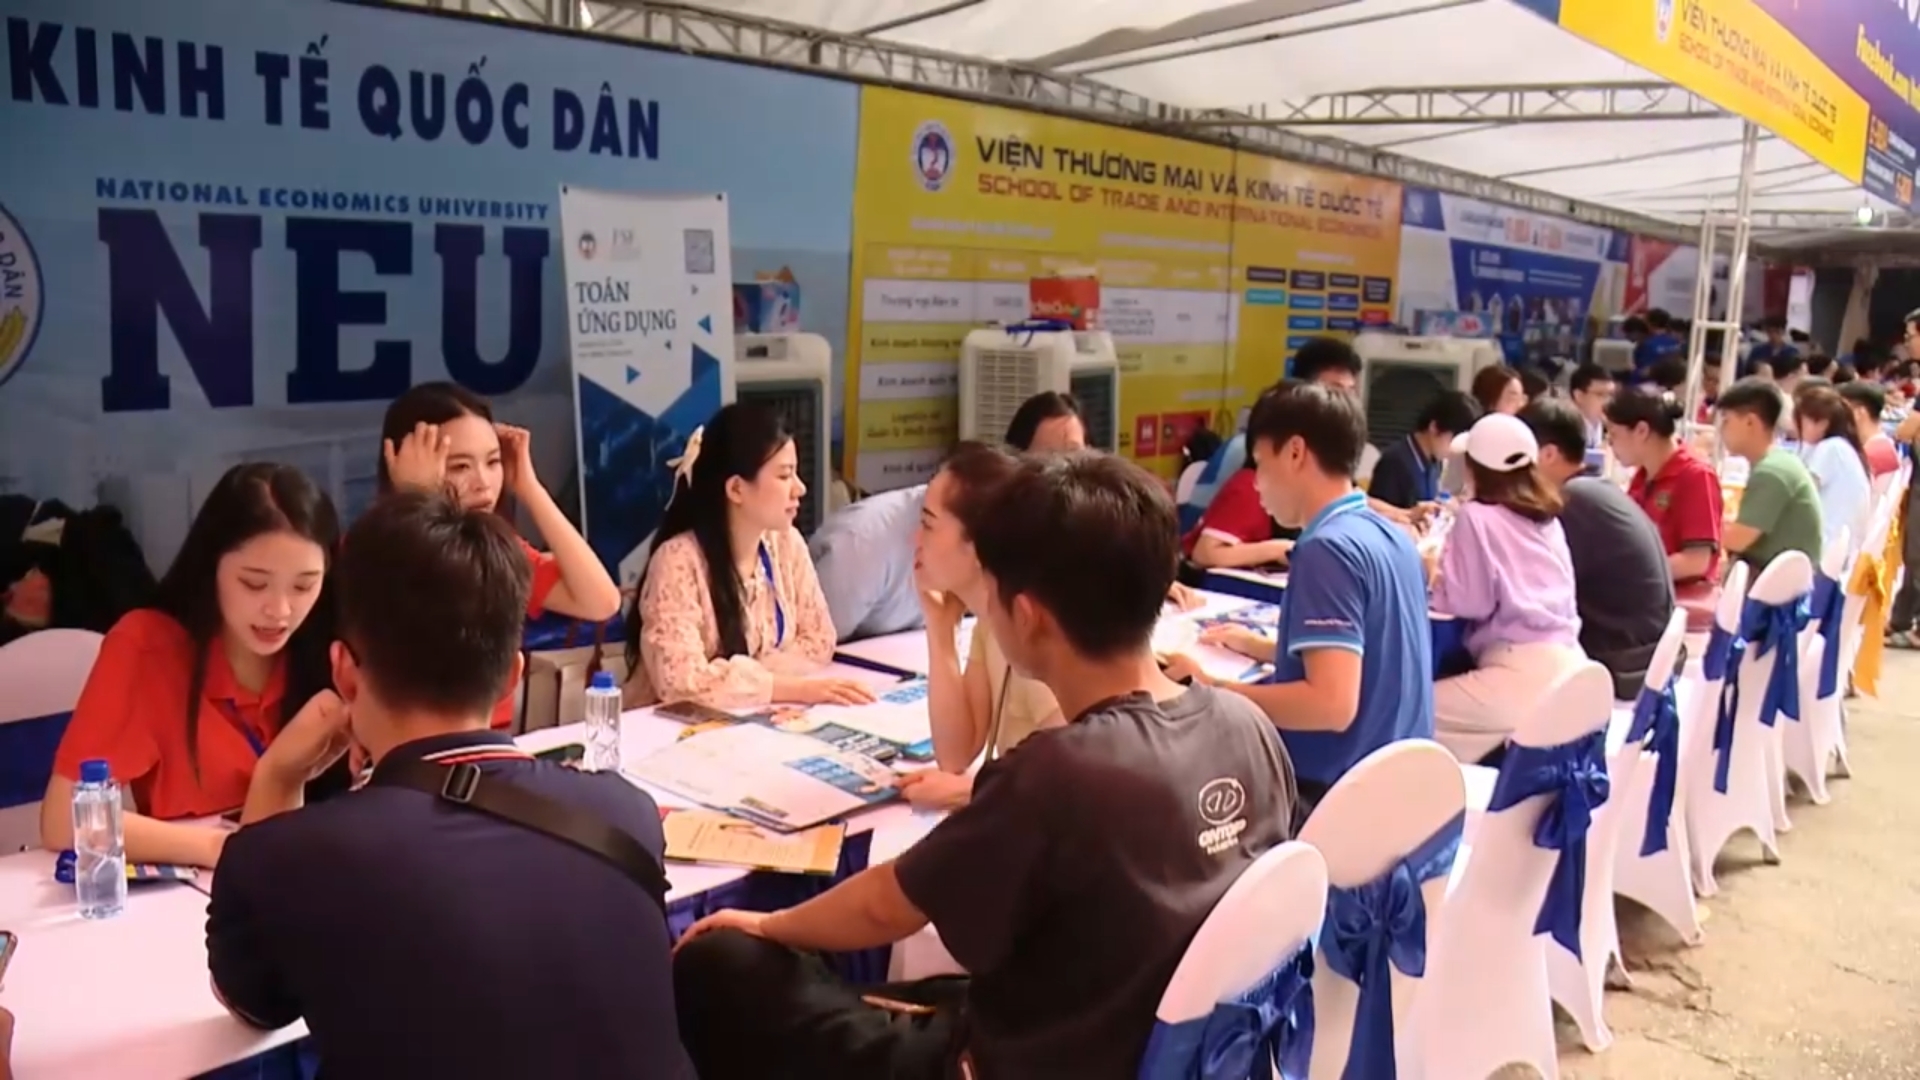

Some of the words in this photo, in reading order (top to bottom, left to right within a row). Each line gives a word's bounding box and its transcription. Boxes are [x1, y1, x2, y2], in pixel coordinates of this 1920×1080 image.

[7, 18, 225, 121] KINH
[255, 34, 331, 131] TẾ
[357, 55, 531, 149] QUỐC
[552, 81, 661, 161] DÂN
[976, 134, 1044, 173] VIỆN
[1053, 148, 1156, 187] THƯƠNG
[1163, 167, 1203, 195] MẠI
[1245, 179, 1290, 204] KINH
[95, 177, 250, 206] NATIONAL
[257, 188, 411, 214] ECONOMICS
[418, 196, 549, 220] UNIVERSITY
[977, 173, 1063, 202] SCHOOL
[1069, 185, 1095, 205] OF
[1101, 188, 1160, 212] TRADE
[1164, 196, 1202, 217] AND
[97, 208, 550, 412] NEU
[576, 277, 630, 304] TOÁN
[577, 308, 622, 335] ỨNG
[625, 310, 677, 339] DỤNG
